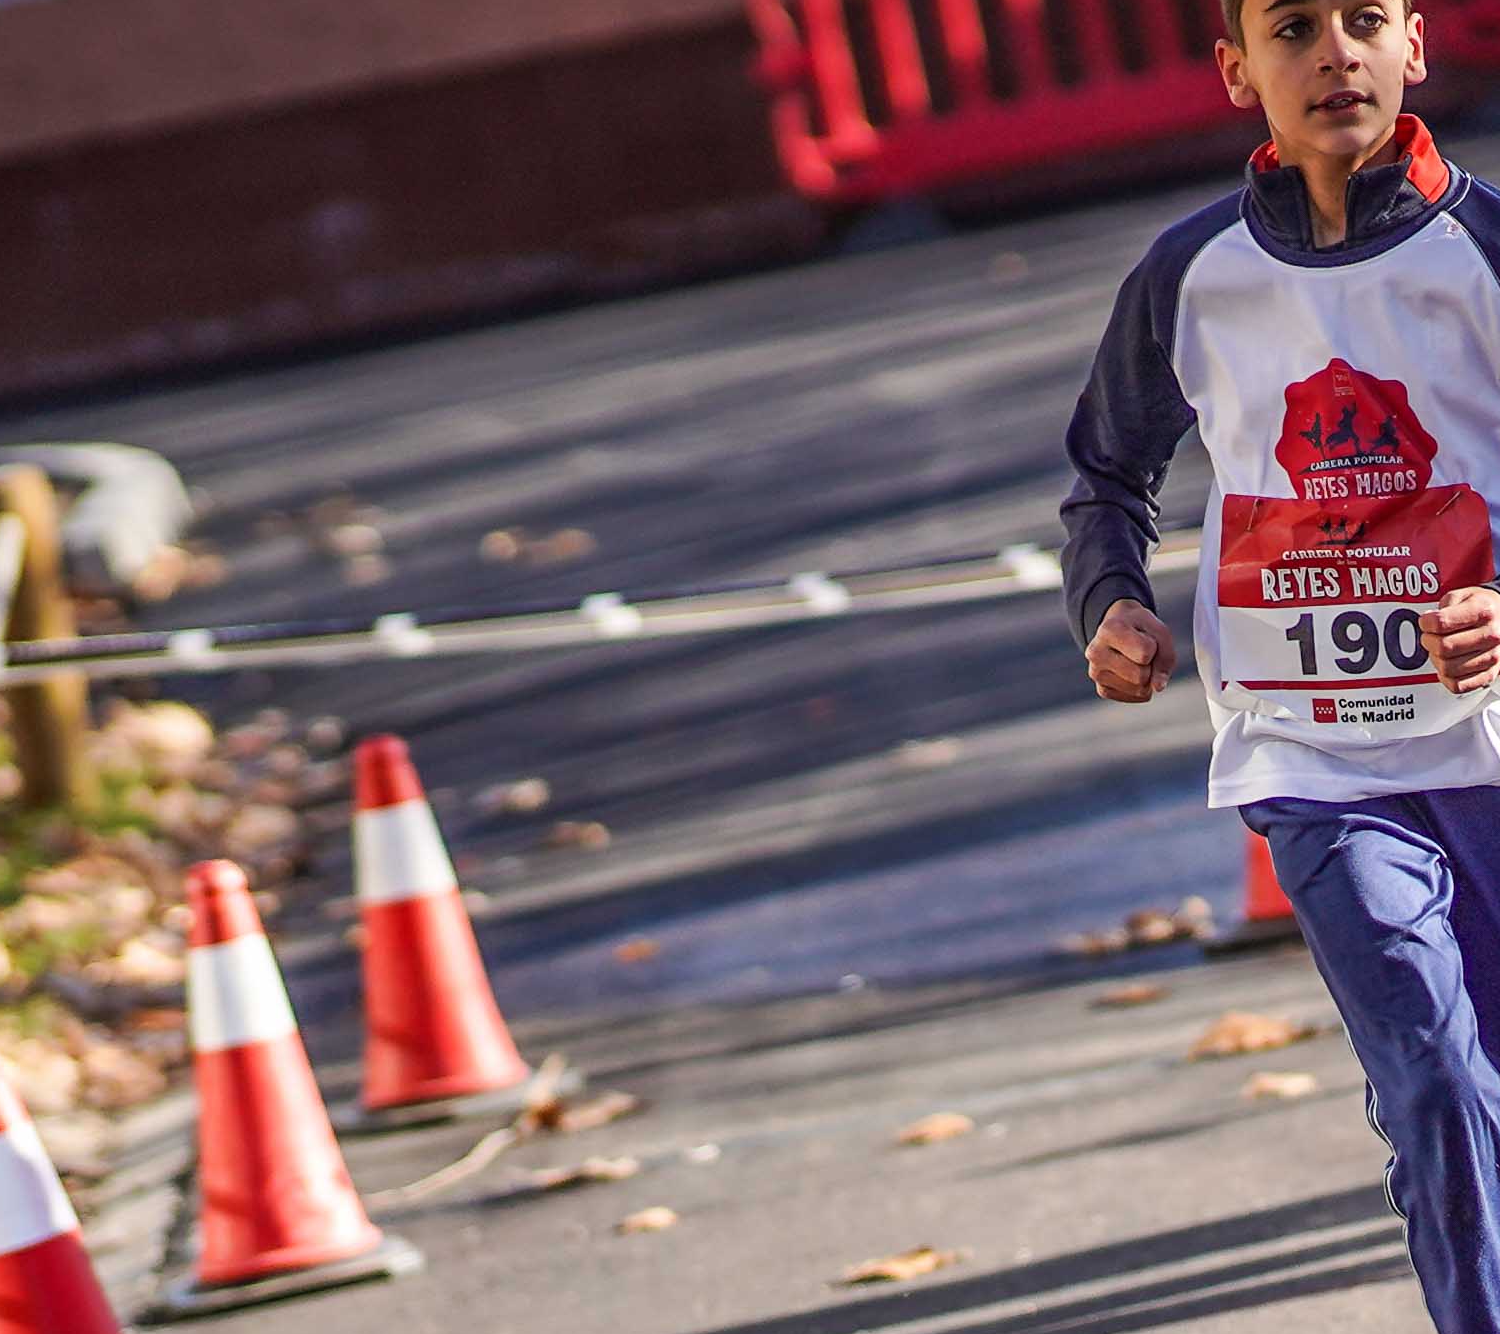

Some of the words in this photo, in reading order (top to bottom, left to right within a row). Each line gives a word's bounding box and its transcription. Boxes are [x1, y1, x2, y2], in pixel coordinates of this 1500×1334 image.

[1310, 459, 1351, 471] CARRERA
[1354, 454, 1404, 466] POPULAR
[1303, 476, 1349, 500] REYES
[1355, 469, 1417, 496] MAGOS
[1282, 549, 1343, 561] CARRERA
[1346, 546, 1411, 558] POPULAR
[1260, 566, 1341, 602] REYES
[1348, 562, 1439, 598] MAGOS
[1285, 608, 1430, 675] 190
[1338, 694, 1414, 709] Comunidad
[1340, 712, 1358, 723] de
[1362, 708, 1415, 723] Madrid
